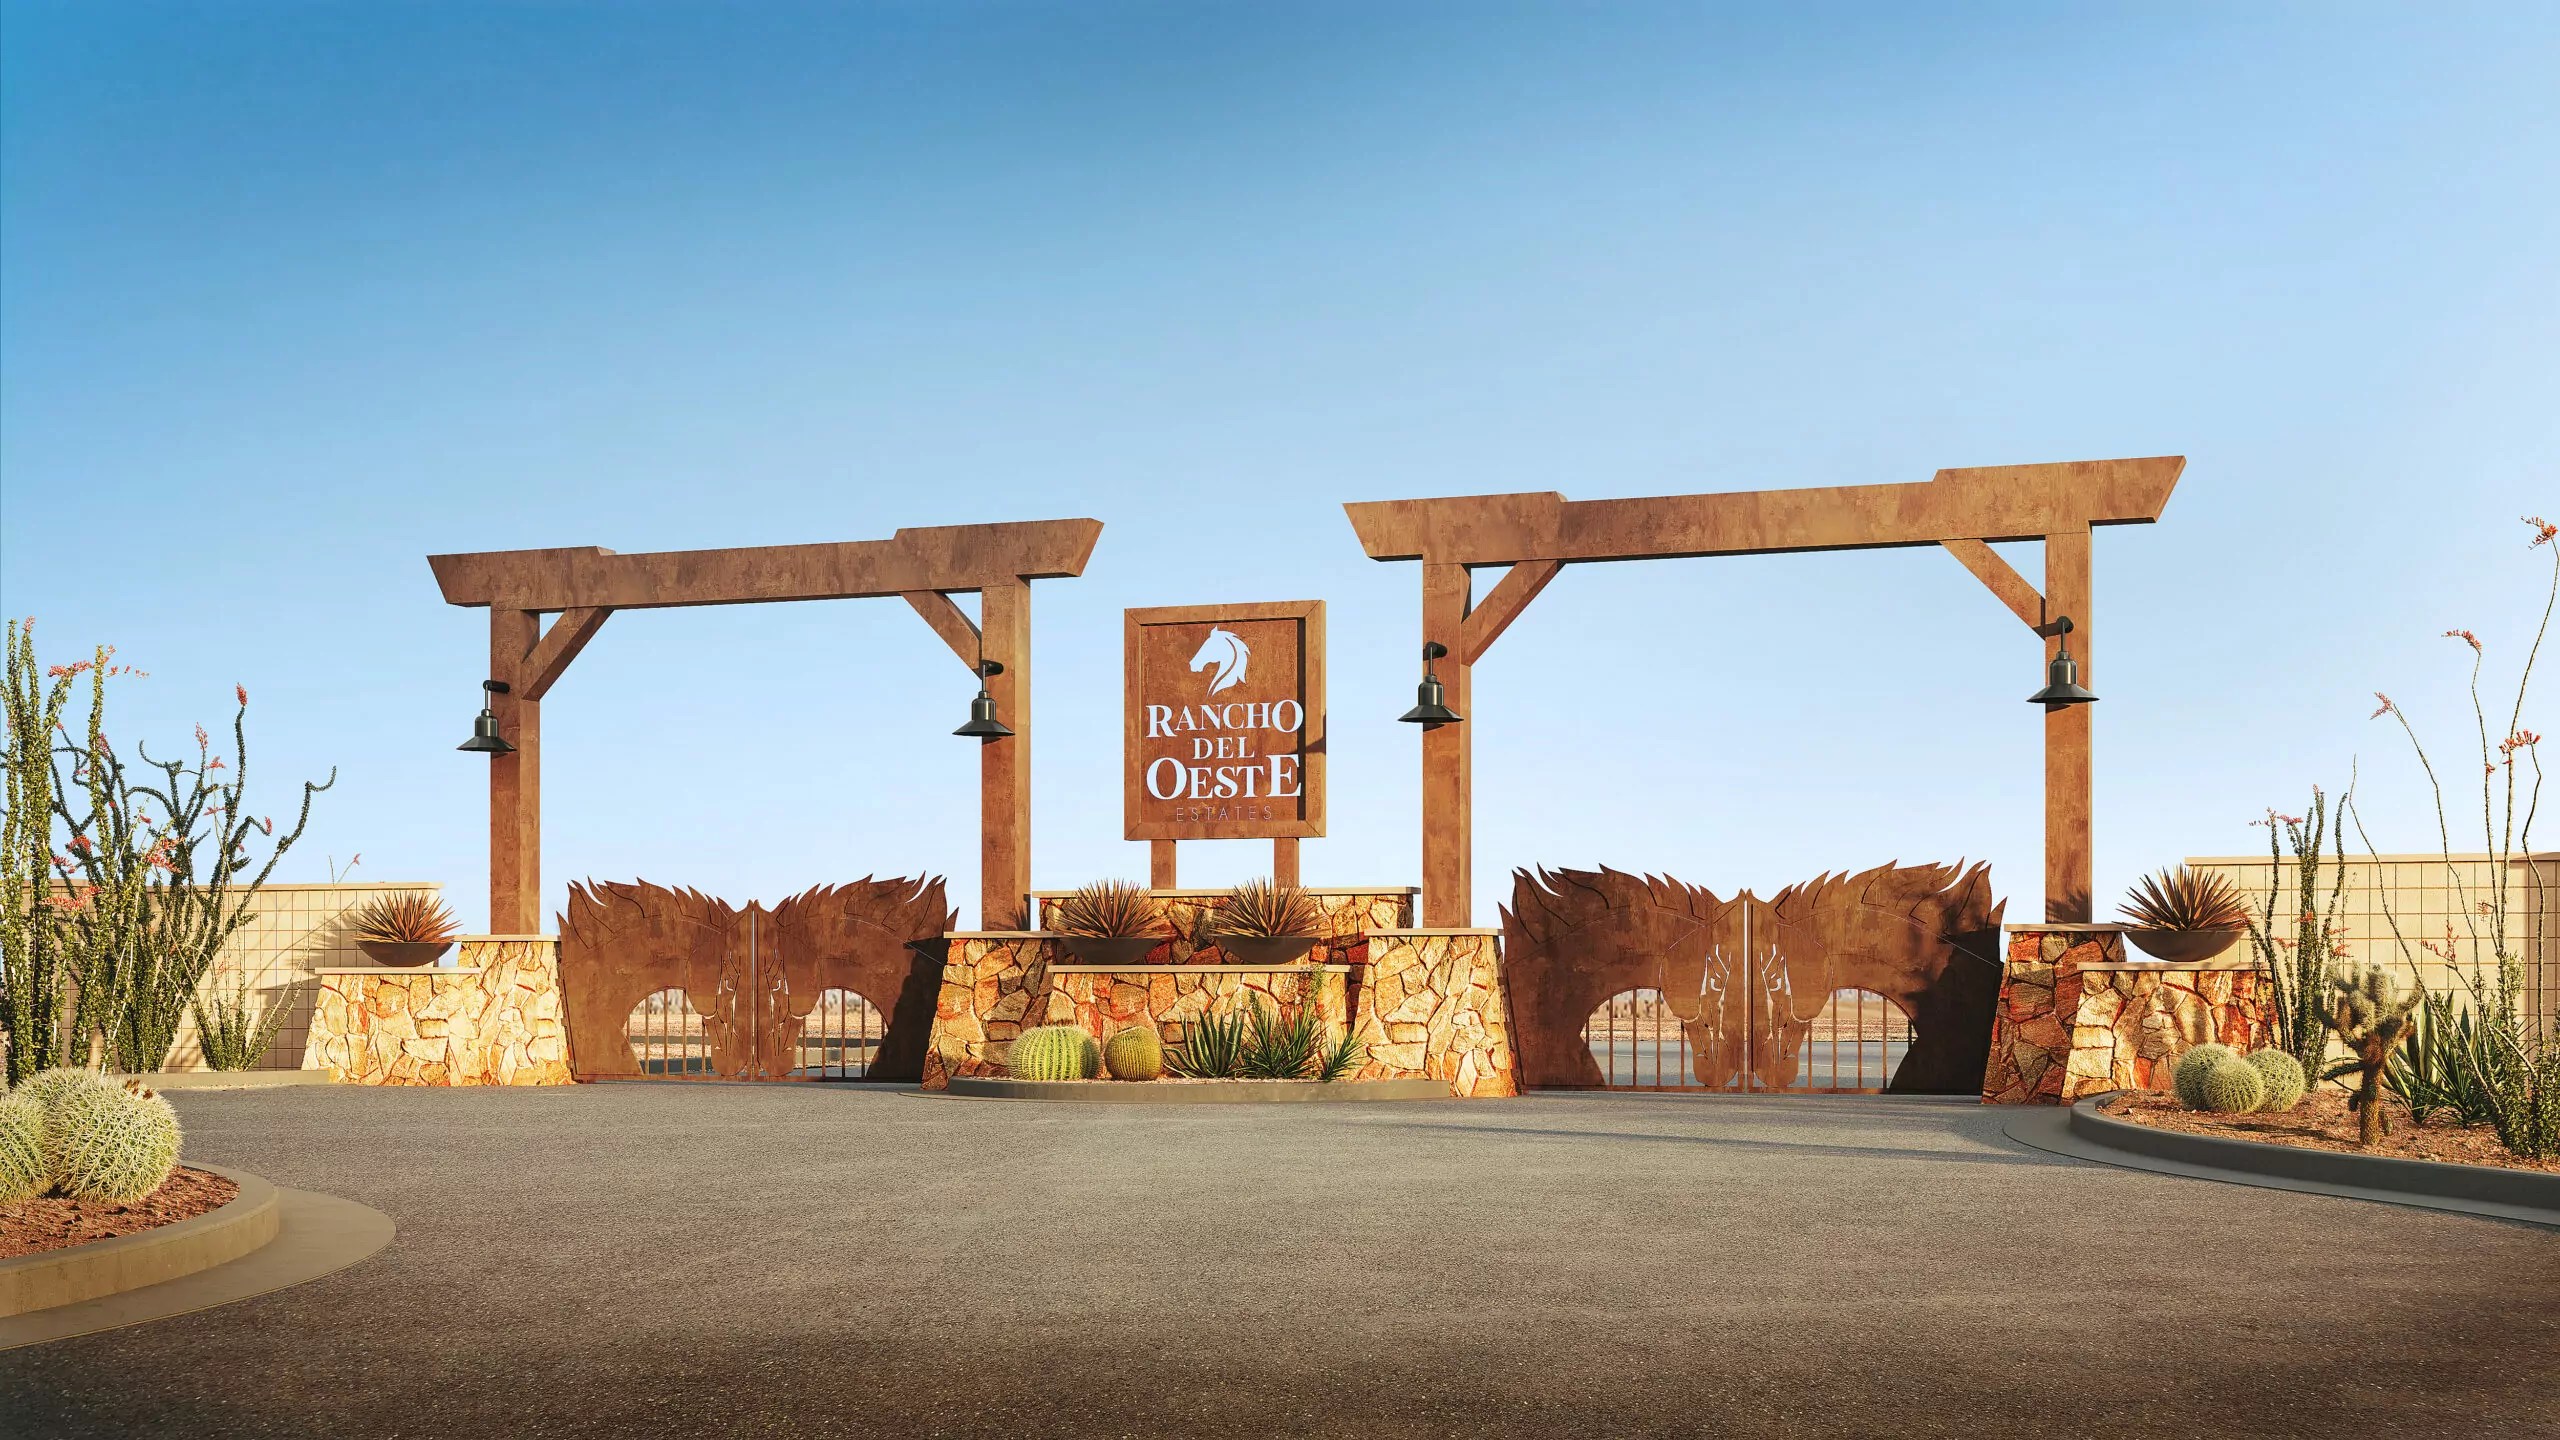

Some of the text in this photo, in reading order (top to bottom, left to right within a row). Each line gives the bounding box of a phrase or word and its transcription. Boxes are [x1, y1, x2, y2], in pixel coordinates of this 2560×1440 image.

[1145, 699, 1304, 738] RANCHO
[1192, 736, 1255, 760] DEL
[1146, 753, 1302, 800] OESTE
[1176, 805, 1272, 822] ESTATES
